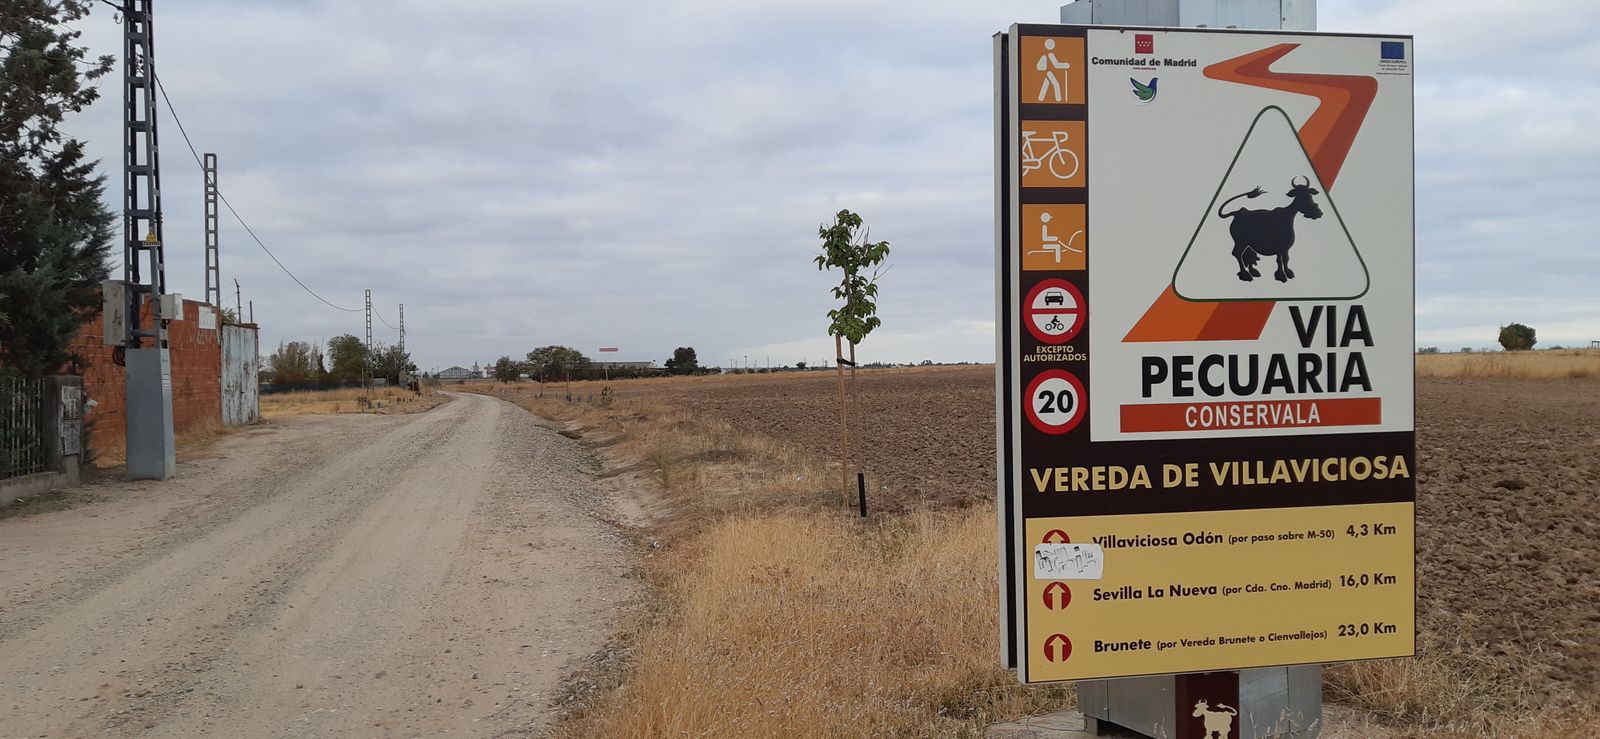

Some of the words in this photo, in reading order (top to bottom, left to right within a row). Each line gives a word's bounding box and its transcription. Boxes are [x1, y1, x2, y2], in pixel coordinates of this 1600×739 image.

[1092, 57, 1146, 66] Comunidad
[1149, 58, 1161, 66] de
[1289, 305, 1375, 347] VIA
[1023, 353, 1086, 362] AUTORIZADOS
[1036, 346, 1074, 354] EXCEPTO
[1142, 352, 1373, 398] PECUARIA
[1038, 390, 1073, 414] 20
[1186, 403, 1320, 428] CONSERVALA
[1030, 464, 1152, 492] VEREDA
[1163, 463, 1199, 487] DE
[1209, 455, 1410, 486] VILLAVICIOSA
[1092, 533, 1178, 550] Villaviciosa
[1183, 532, 1223, 546] Odón
[1228, 533, 1249, 545] (por
[1252, 532, 1274, 543] paso
[1277, 531, 1304, 541] sobre
[1307, 529, 1335, 540] M-50)
[1346, 524, 1369, 537] 4,3
[1373, 523, 1396, 535] Km
[1093, 587, 1143, 601] Sevilla
[1147, 586, 1164, 598] La
[1169, 583, 1217, 597] Nueva
[1222, 585, 1242, 596] (por
[1245, 583, 1267, 594] Cda.
[1270, 582, 1292, 592] Cno.
[1294, 579, 1332, 591] Madrid)
[1339, 574, 1369, 588] 16,0
[1373, 573, 1397, 585] Km
[1094, 638, 1151, 653] Brunete
[1157, 639, 1177, 651] (por
[1181, 637, 1216, 648] Vereda
[1219, 634, 1255, 645] Brunete
[1268, 630, 1327, 642] Cienvallejos)
[1338, 623, 1369, 638] 23,0
[1374, 622, 1397, 635] Km
